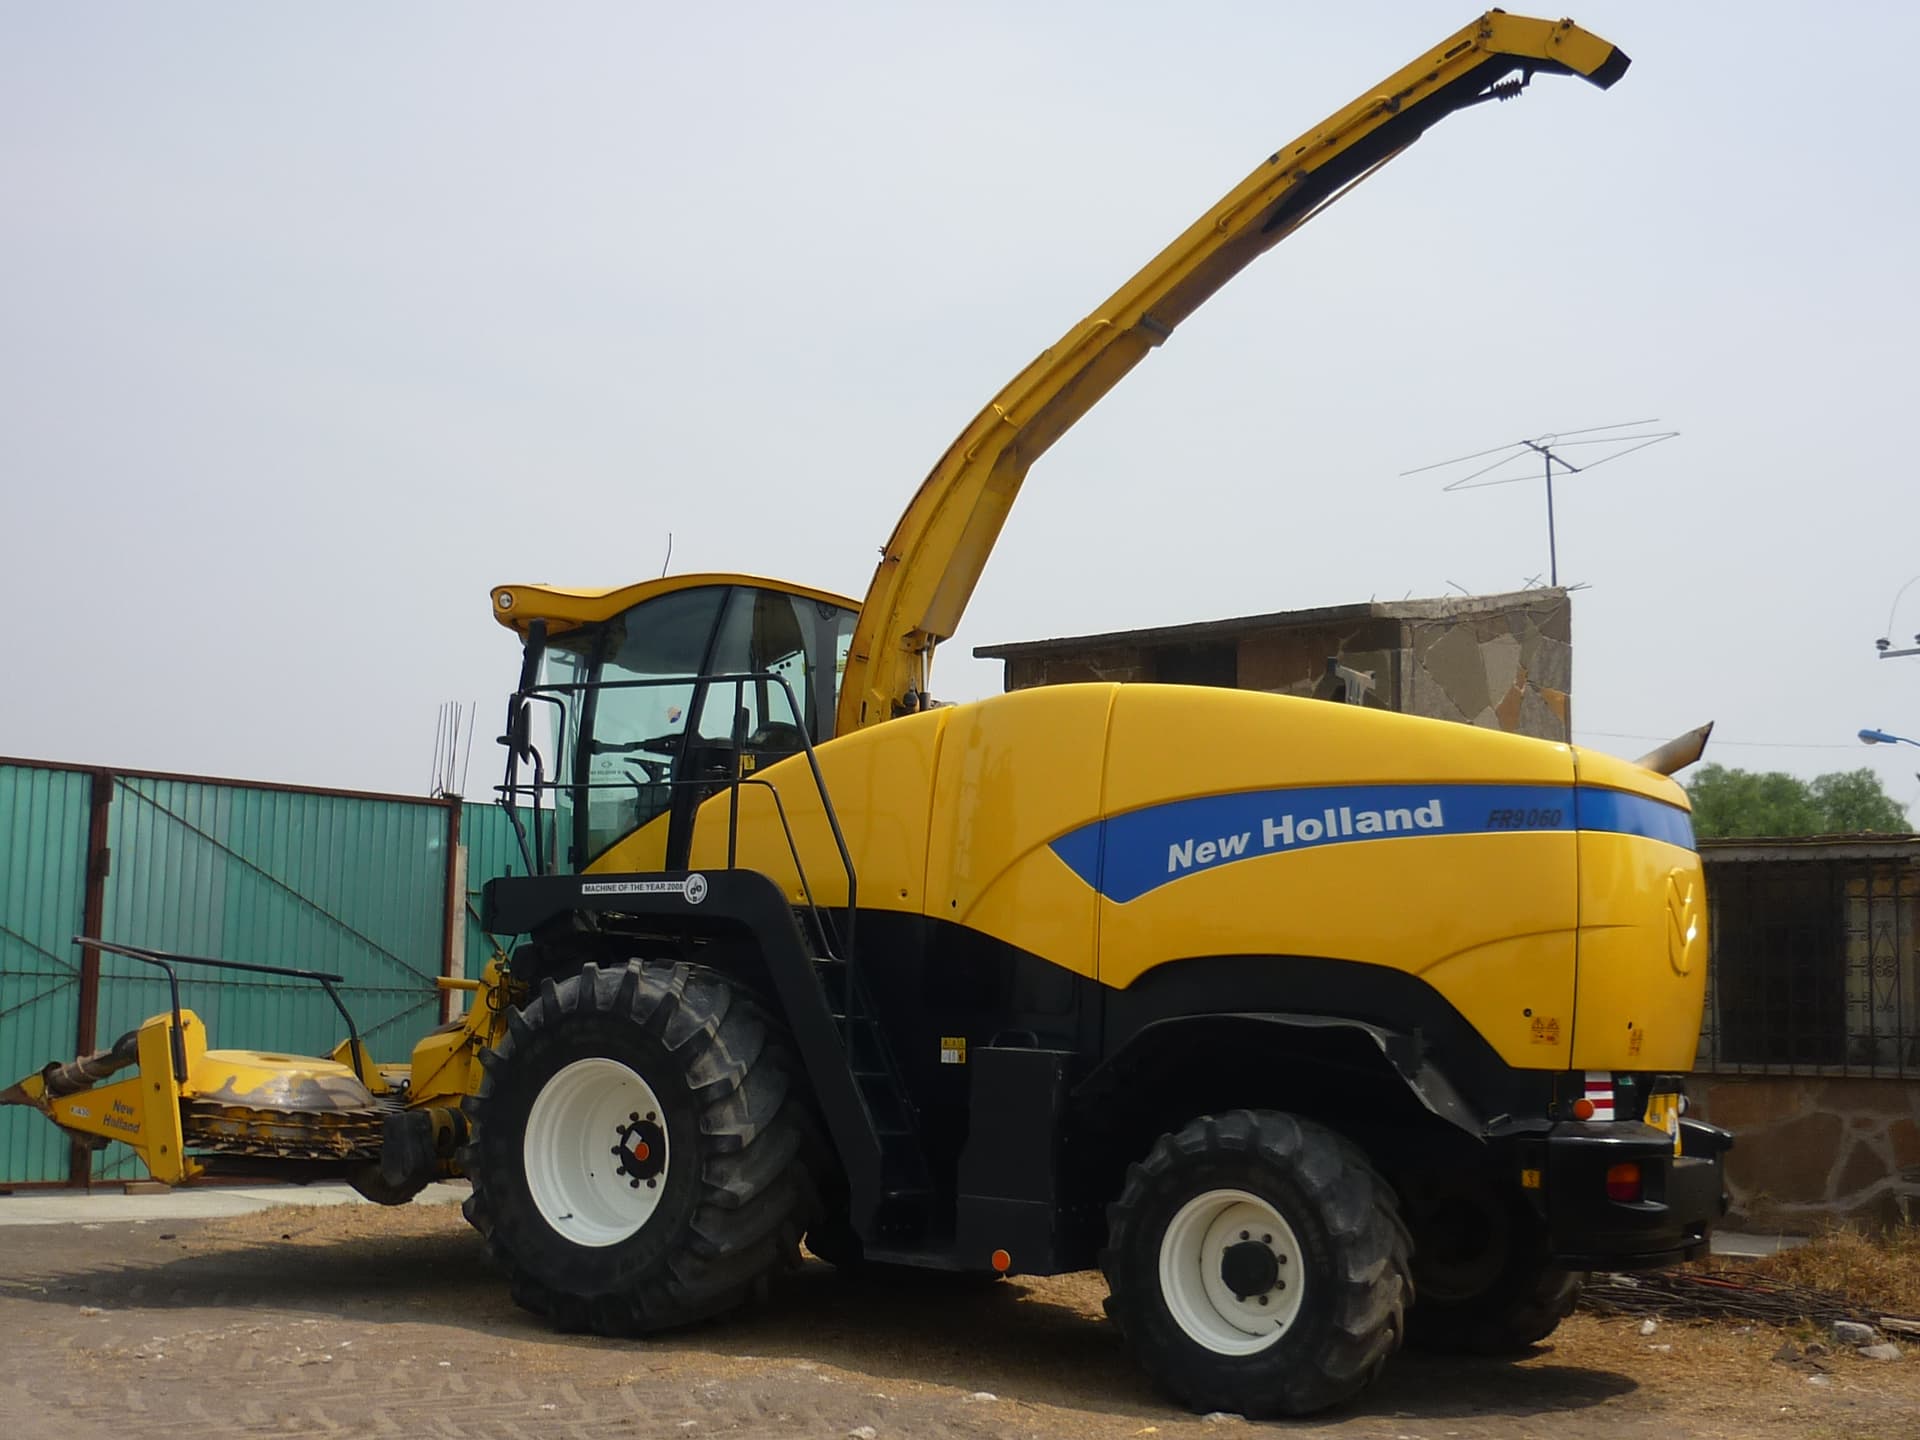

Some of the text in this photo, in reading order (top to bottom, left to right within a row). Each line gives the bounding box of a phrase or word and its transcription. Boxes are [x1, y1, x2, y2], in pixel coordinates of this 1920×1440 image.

[1487, 808, 1562, 829] FR9060
[1167, 799, 1445, 873] New Holland
[584, 884, 617, 893] MACHINE
[618, 884, 628, 892] OF
[630, 883, 645, 892] THE
[646, 883, 665, 891] YEAR
[113, 1098, 135, 1115] New
[103, 1112, 142, 1134] Holland
